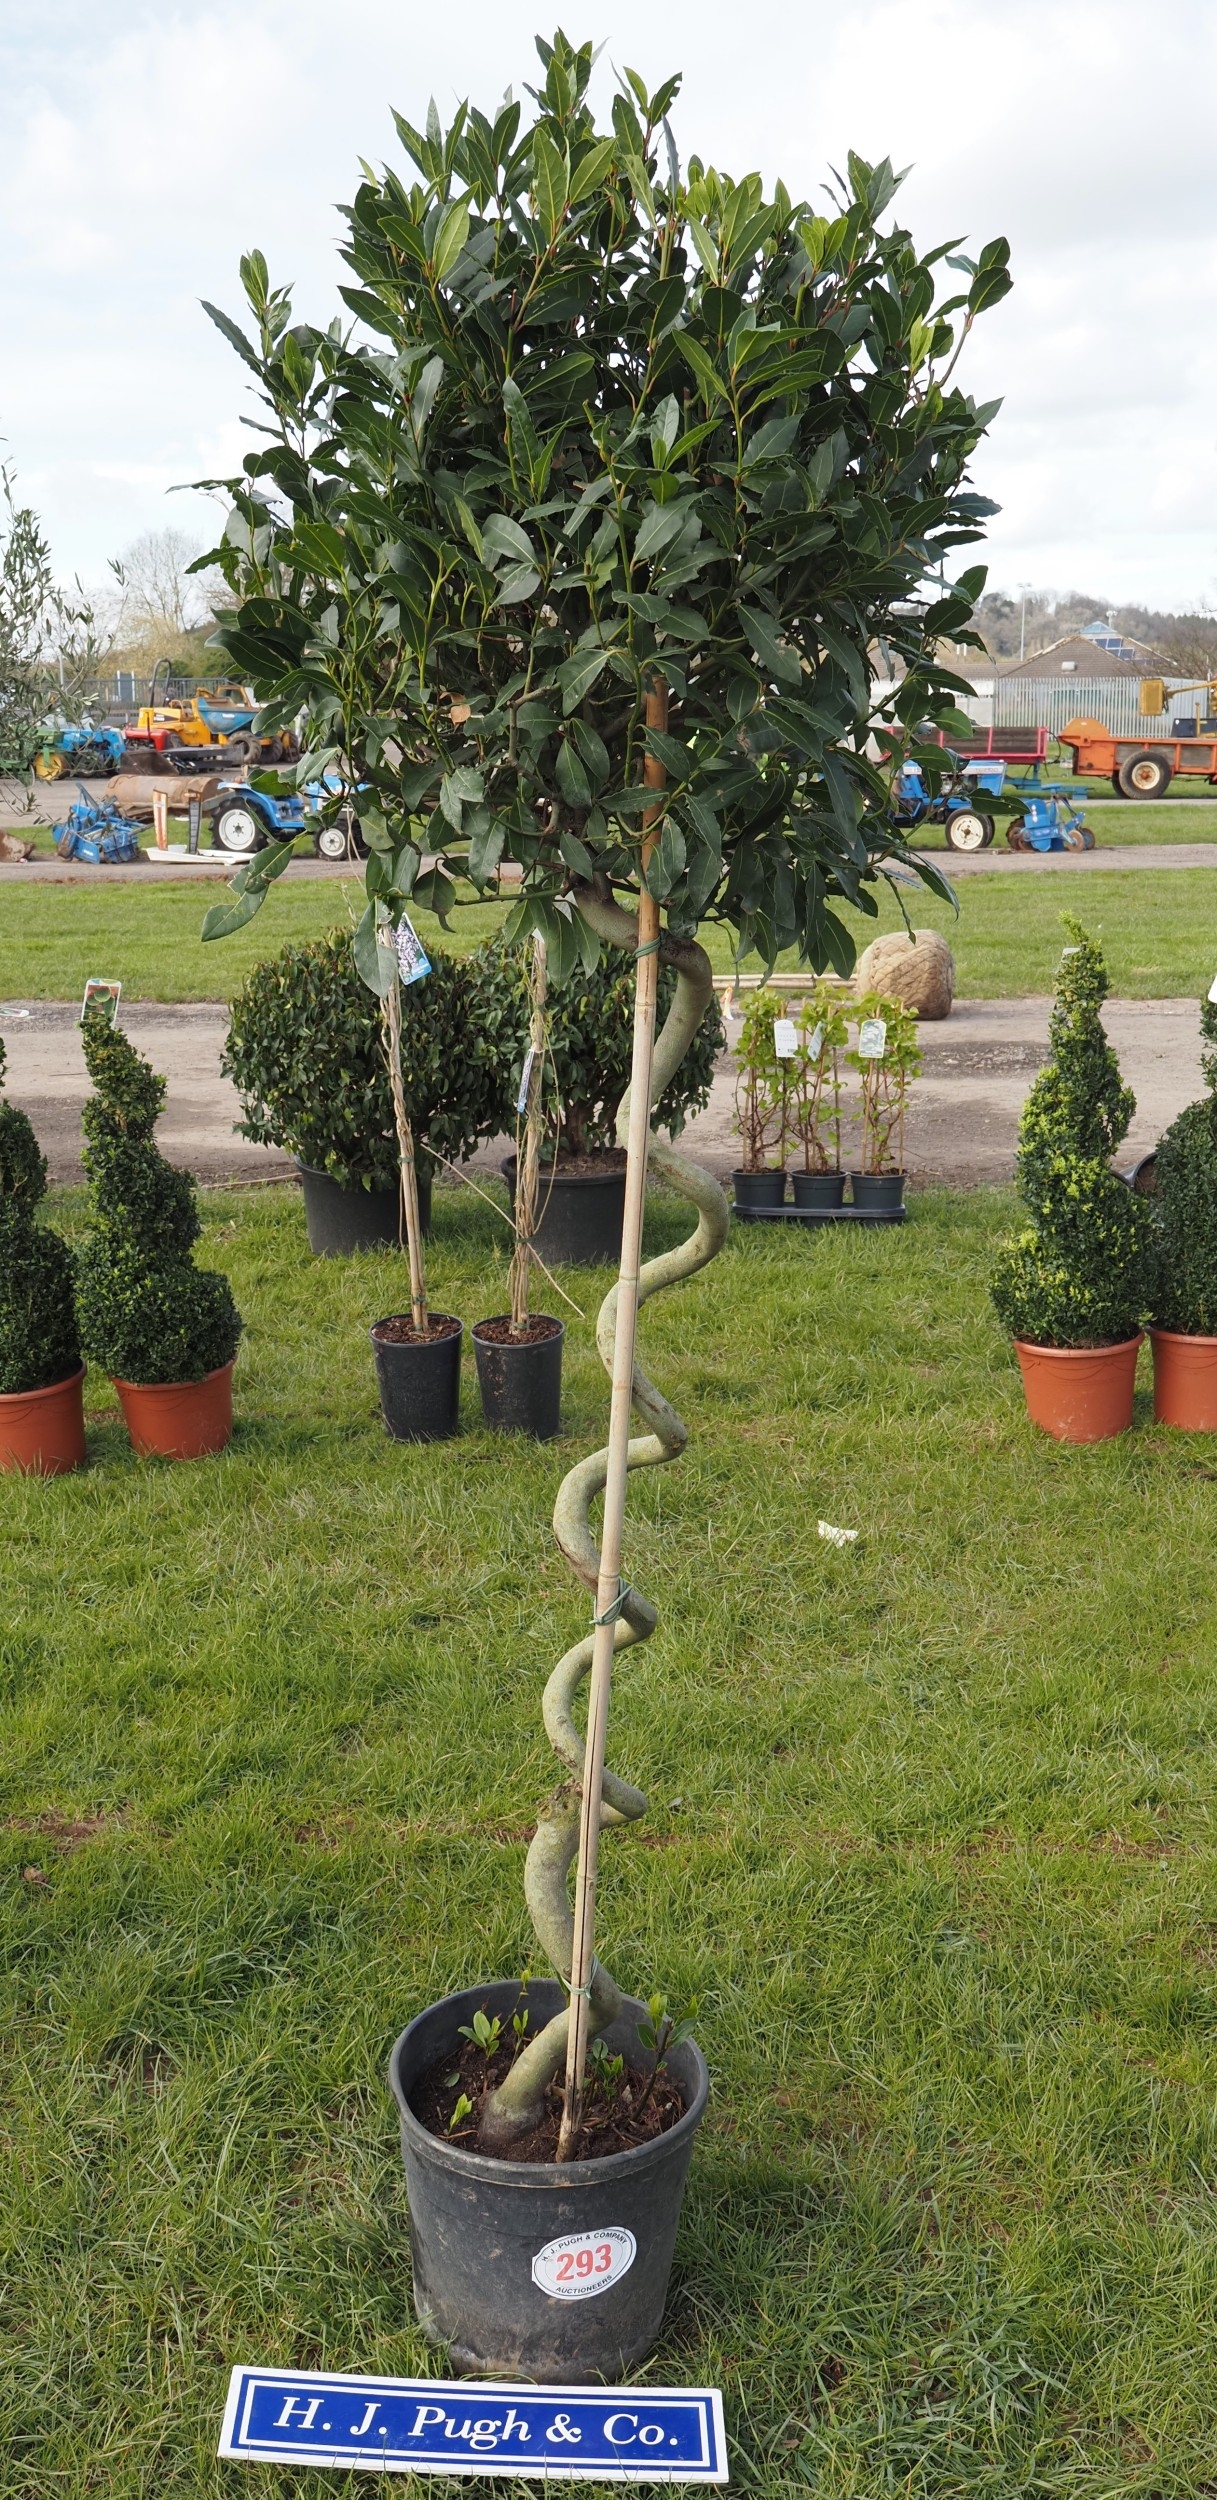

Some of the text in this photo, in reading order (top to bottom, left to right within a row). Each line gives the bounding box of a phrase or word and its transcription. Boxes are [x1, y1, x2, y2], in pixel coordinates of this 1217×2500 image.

[558, 2236, 583, 2249] PUGH
[593, 2232, 628, 2245] COMPANY
[556, 2244, 612, 2281] 293
[555, 2275, 613, 2294] AUCTIONEERS
[273, 2396, 678, 2450] H. J. Pugh & Co.
